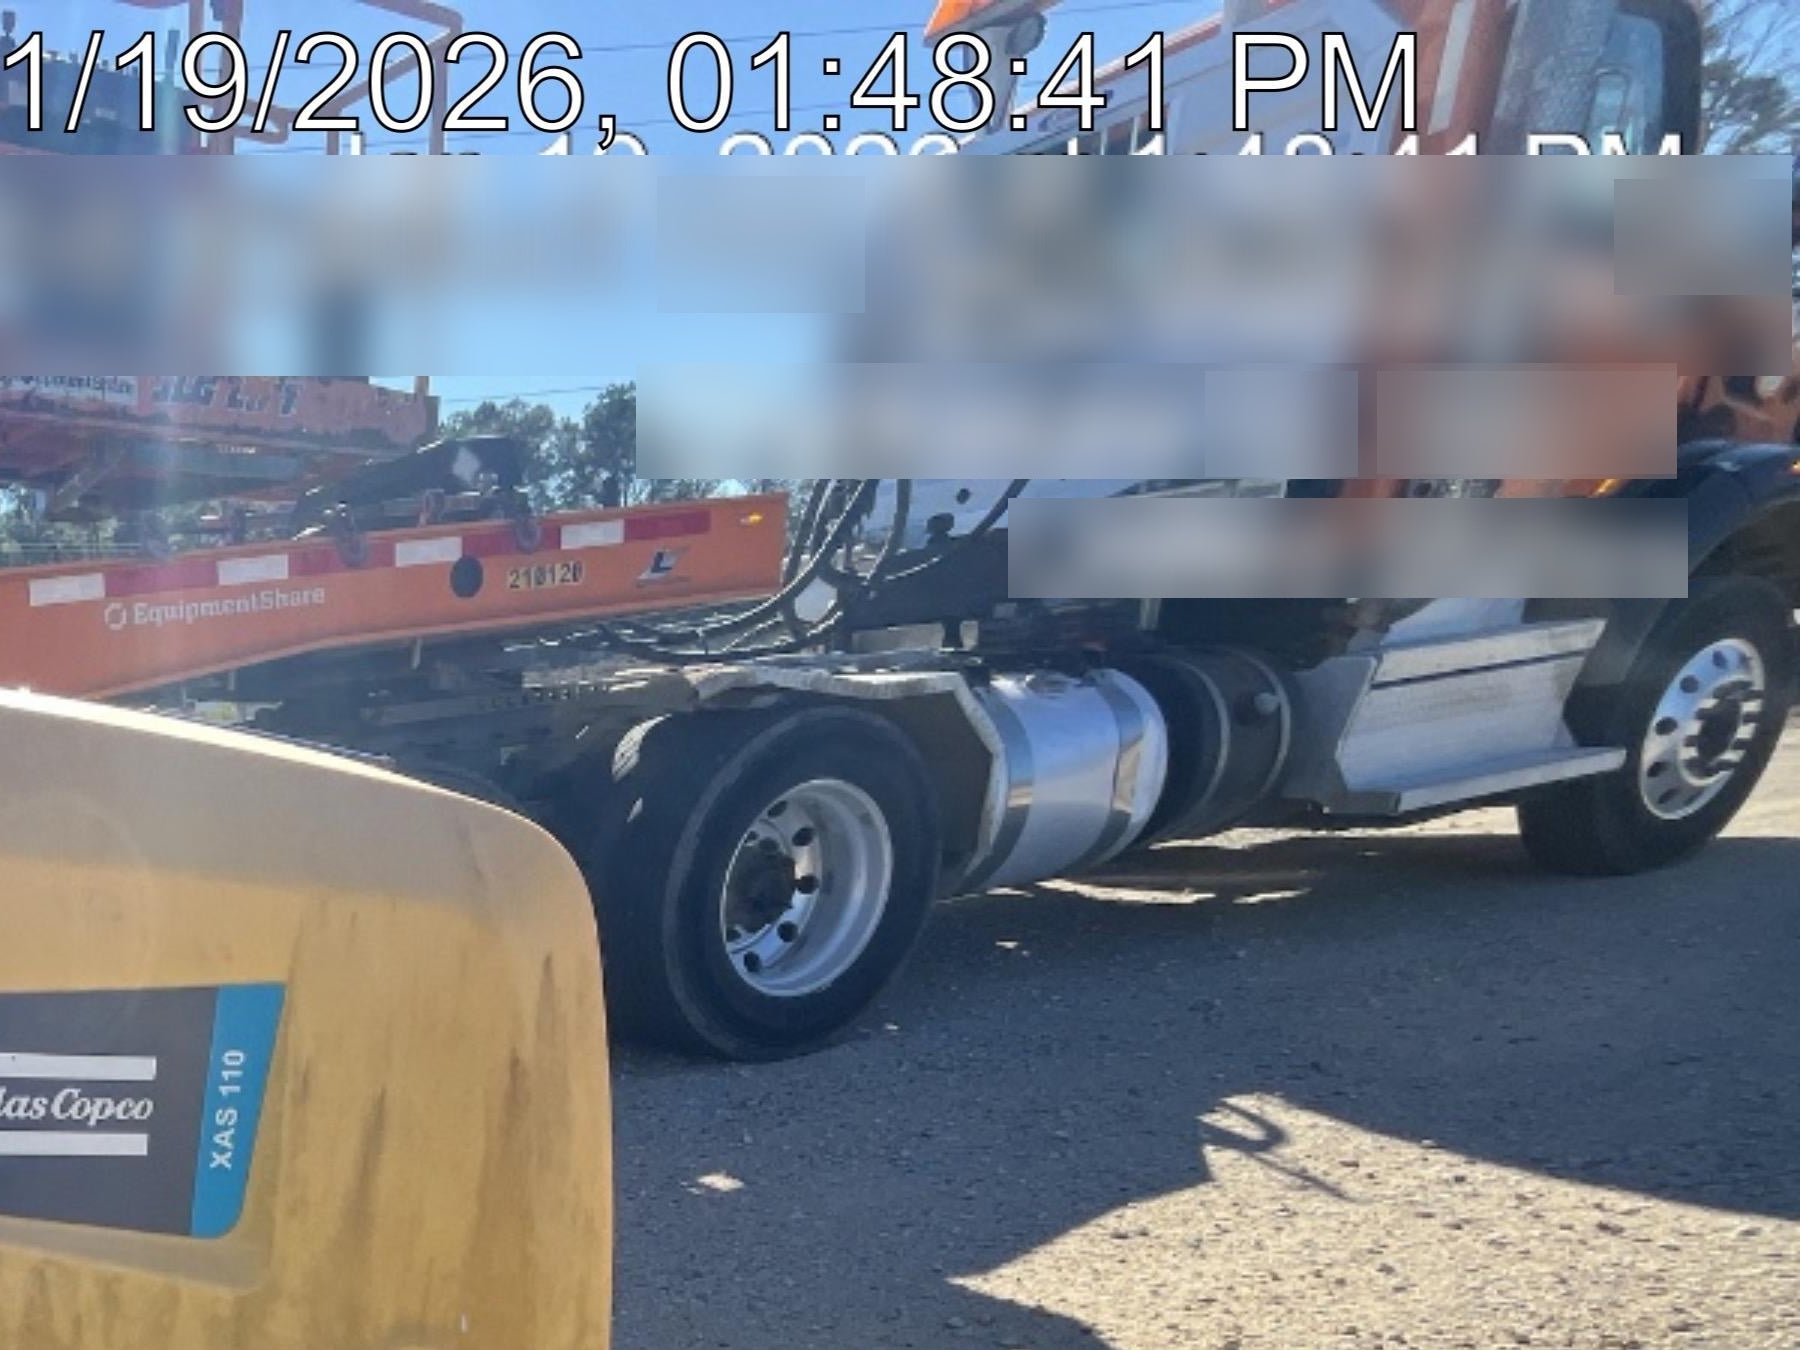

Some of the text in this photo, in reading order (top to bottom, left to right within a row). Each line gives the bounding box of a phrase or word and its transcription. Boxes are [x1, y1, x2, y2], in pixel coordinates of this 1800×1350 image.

[133, 588, 325, 626] EquipmentShare
[209, 1049, 246, 1171] XAS 110
